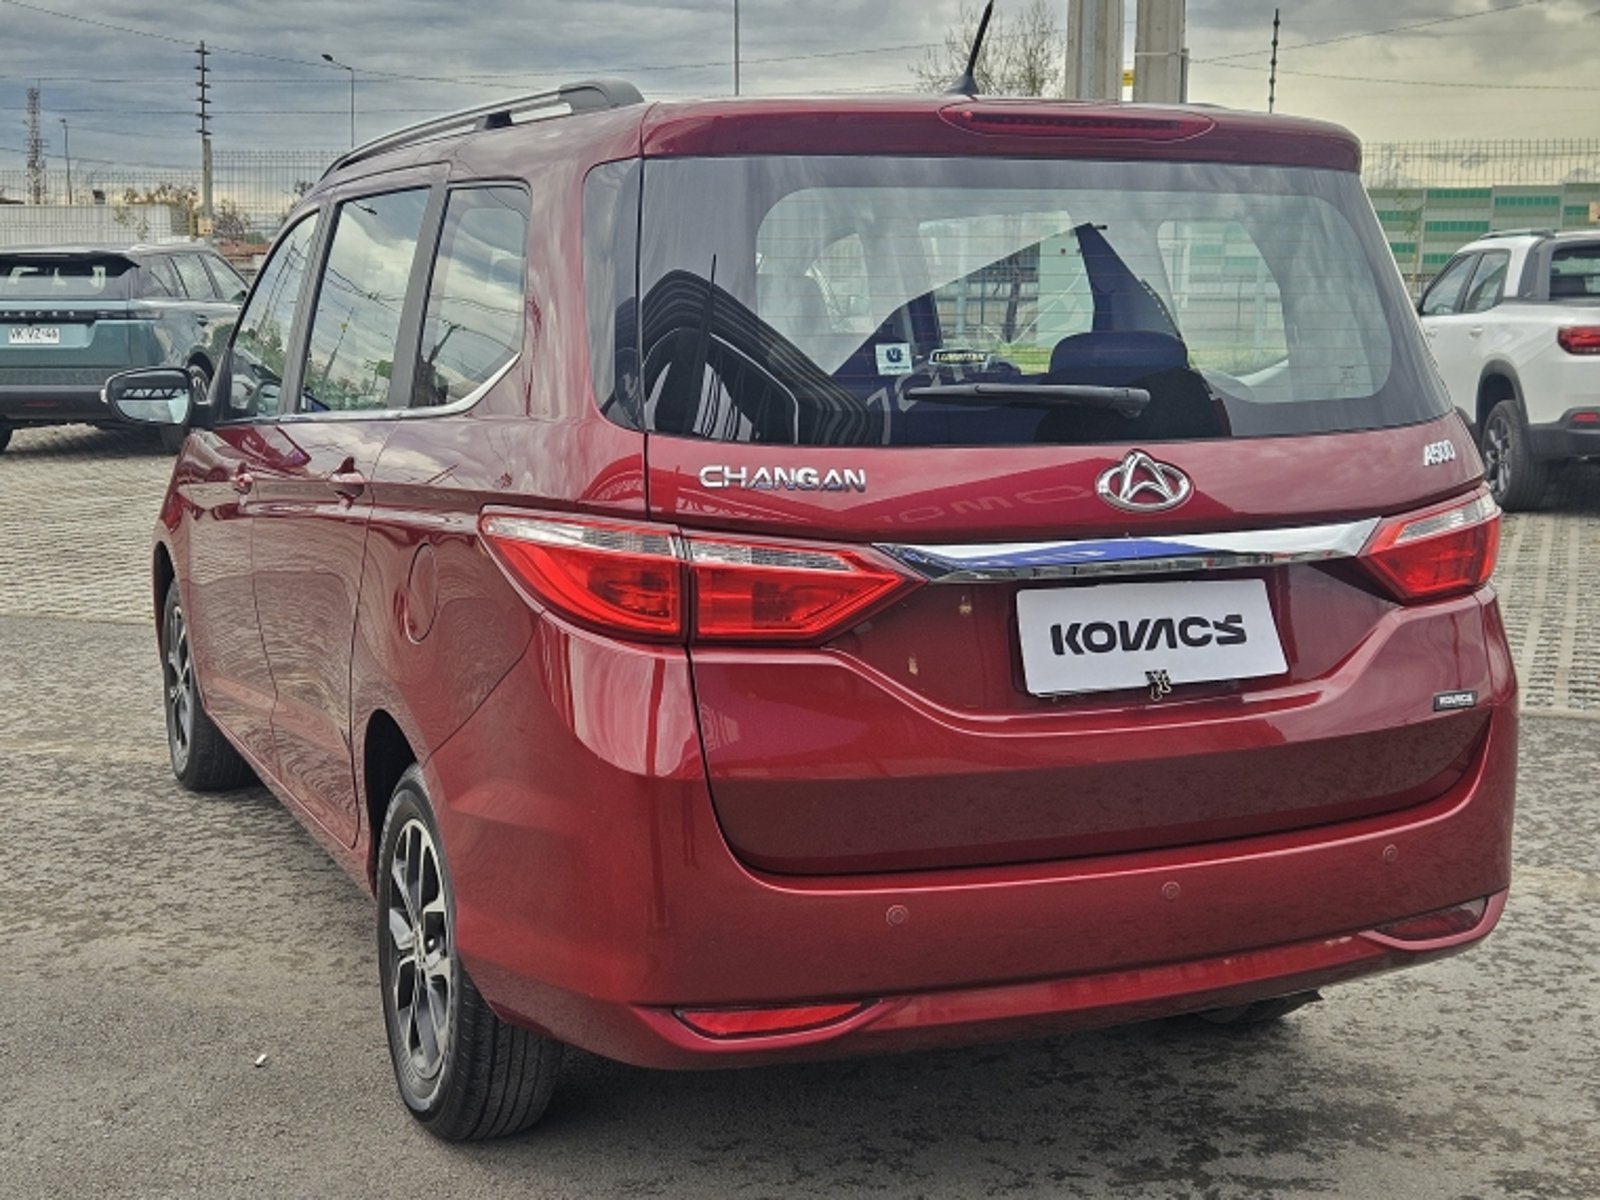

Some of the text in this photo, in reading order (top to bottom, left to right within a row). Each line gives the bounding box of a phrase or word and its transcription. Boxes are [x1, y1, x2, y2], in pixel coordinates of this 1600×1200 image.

[1423, 439, 1456, 466] A500
[698, 465, 867, 492] CHANGAN
[1050, 614, 1247, 655] KOVACS
